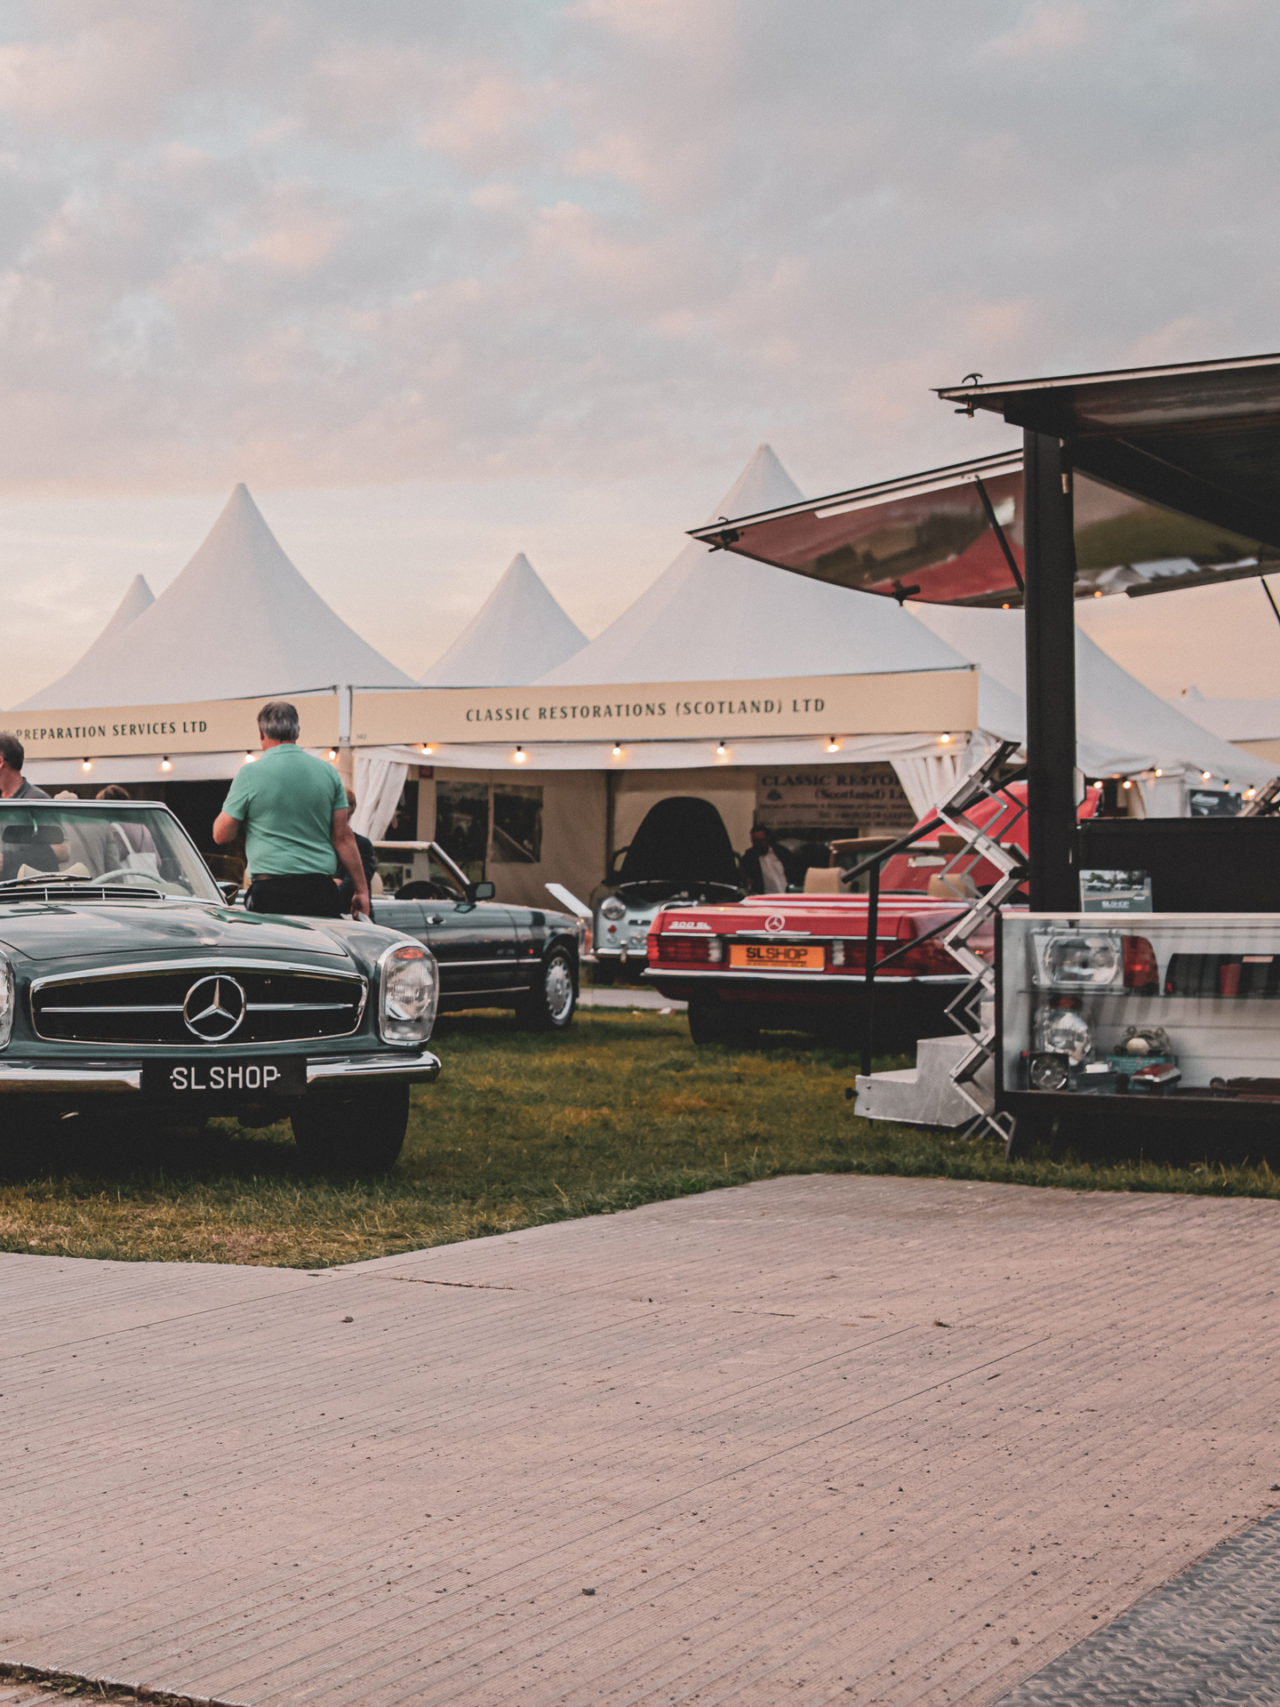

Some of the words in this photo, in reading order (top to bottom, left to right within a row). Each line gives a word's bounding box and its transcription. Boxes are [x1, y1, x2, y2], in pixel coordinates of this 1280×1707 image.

[465, 707, 531, 722] CLASSIC
[537, 703, 667, 720] RESTORATIONS
[675, 700, 783, 716] (SCOTLAND)
[791, 698, 826, 713] LTD
[16, 725, 107, 740] PREPARATION
[112, 721, 177, 736] SERVICES
[182, 720, 208, 733] LTD
